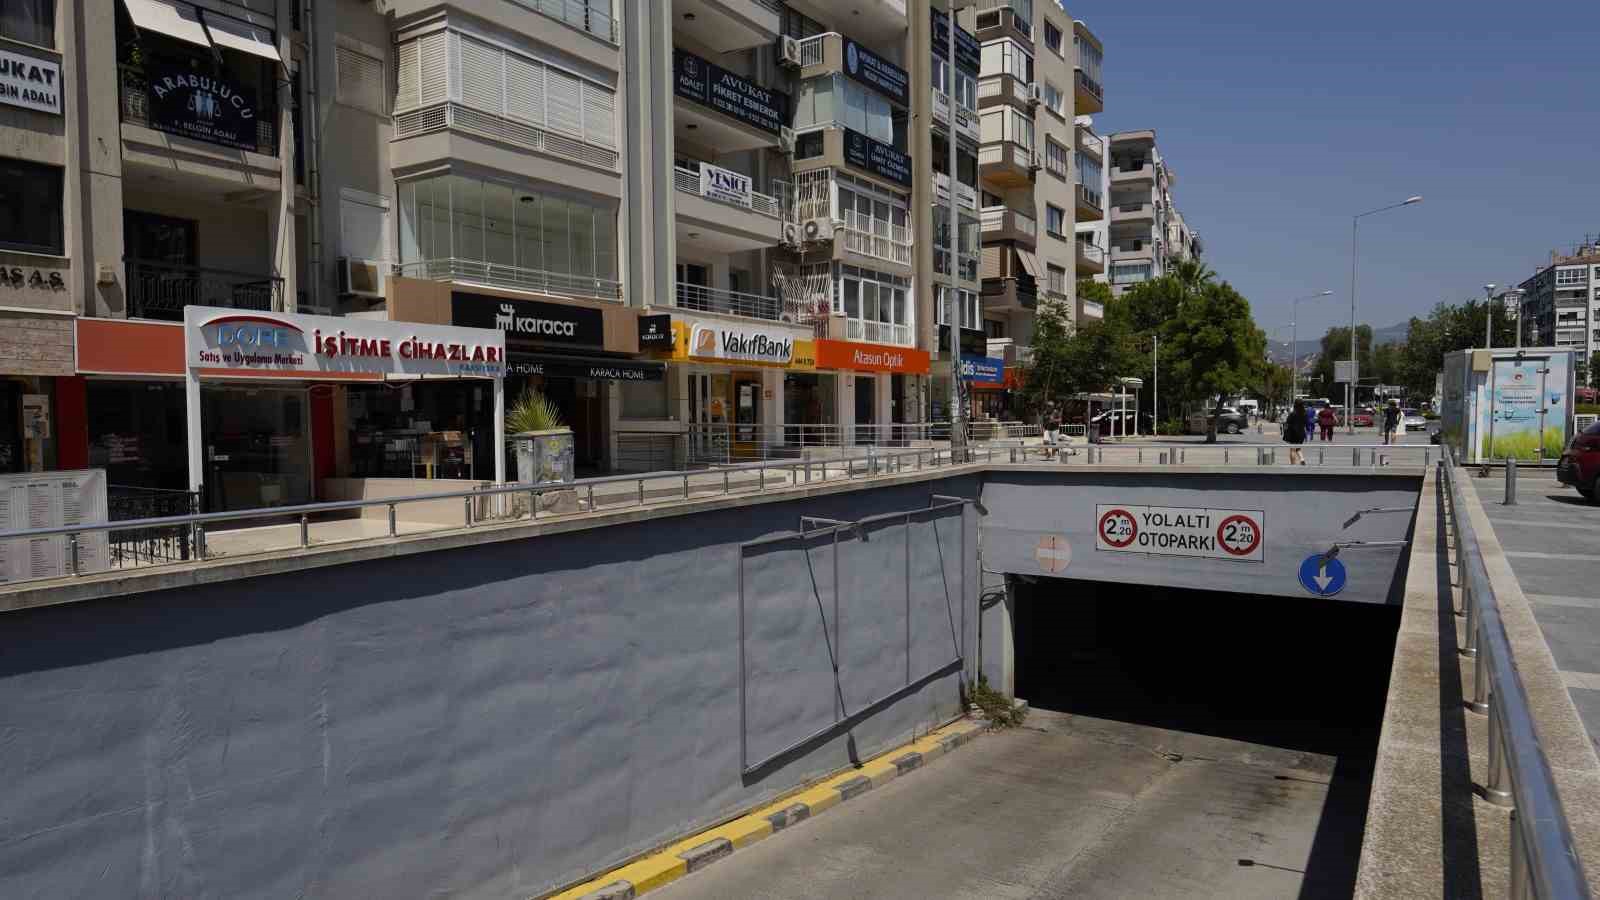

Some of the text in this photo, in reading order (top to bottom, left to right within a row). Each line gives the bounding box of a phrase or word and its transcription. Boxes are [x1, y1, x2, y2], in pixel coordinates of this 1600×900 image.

[153, 74, 253, 119] ARABULUCU
[722, 74, 772, 102] AVUKAT
[516, 317, 575, 337] karaca
[315, 329, 503, 362] İŞİTME CİHAZLARI
[721, 331, 791, 357] VakıfBank
[222, 353, 232, 362] ve
[854, 349, 882, 366] Atasun
[516, 364, 545, 375] HOME
[590, 367, 621, 378] KARACA
[1142, 512, 1209, 528] YOLALTI
[1139, 532, 1215, 551] OTOPARKI
